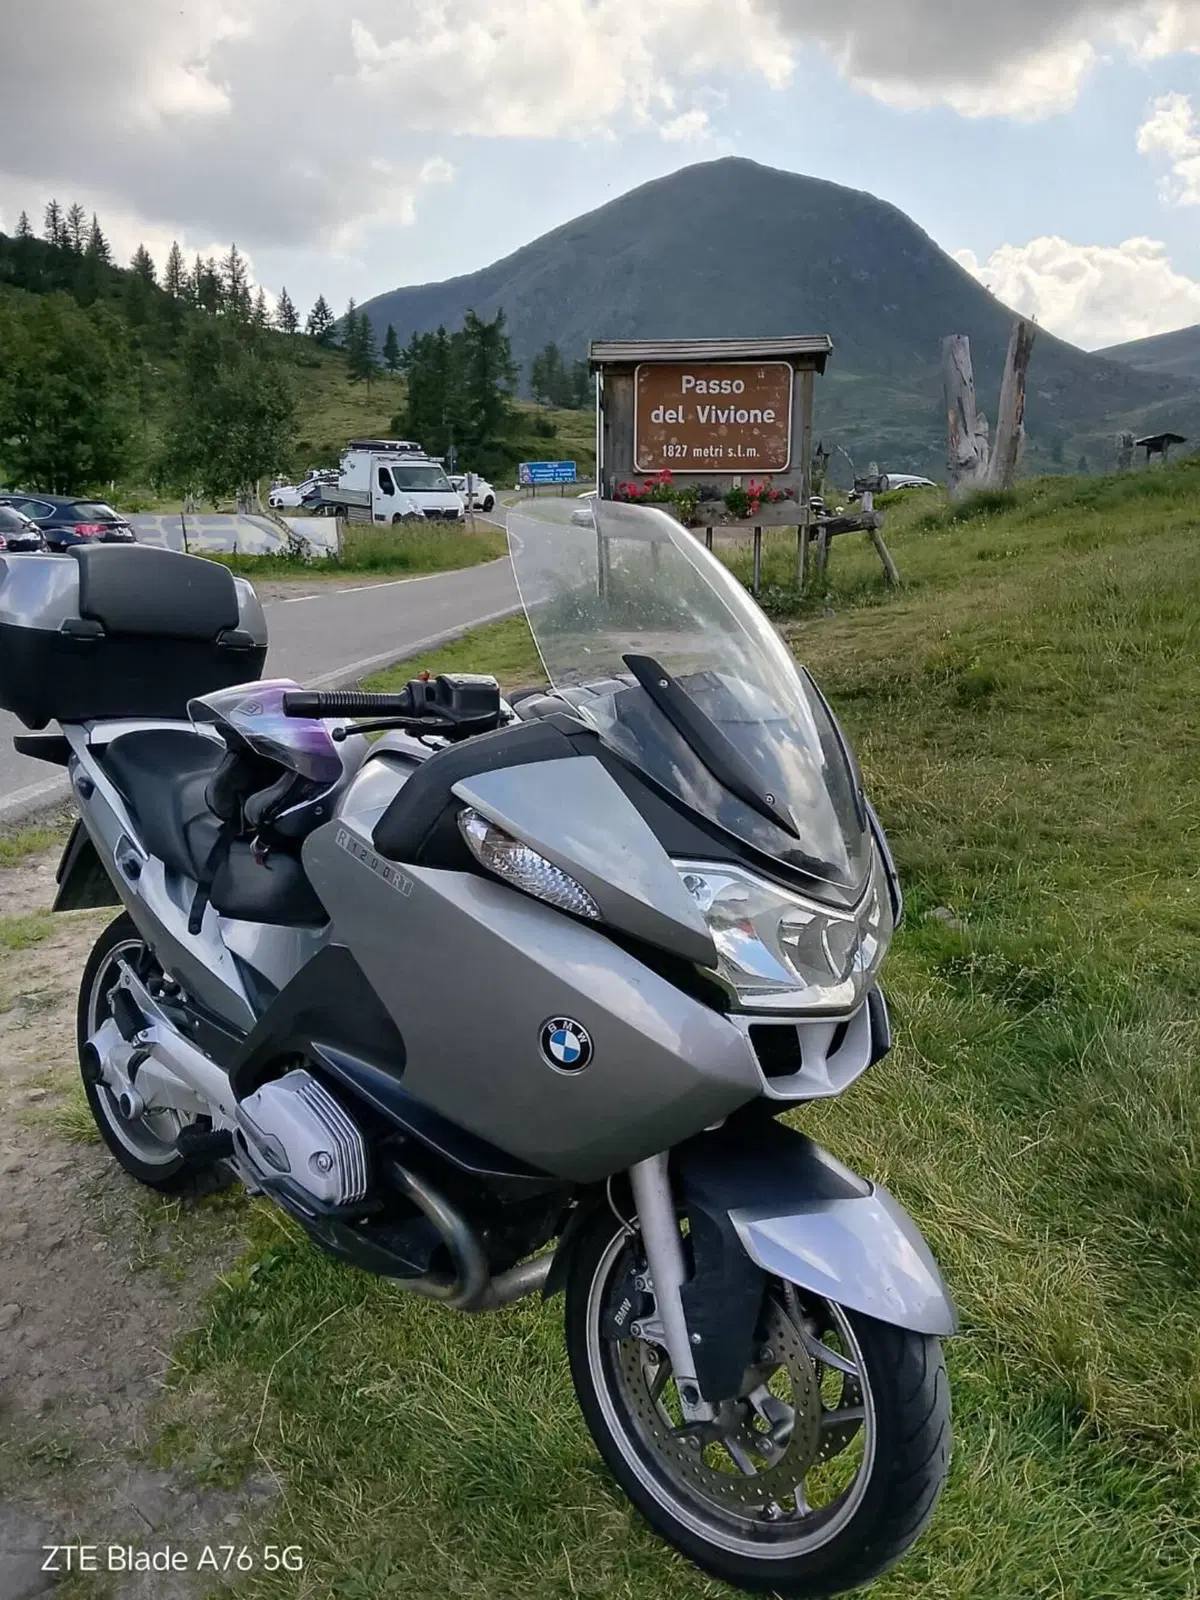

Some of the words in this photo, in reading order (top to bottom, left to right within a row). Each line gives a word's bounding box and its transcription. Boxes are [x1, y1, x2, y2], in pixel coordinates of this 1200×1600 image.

[681, 375, 745, 394] Passo
[650, 405, 685, 424] del
[697, 405, 776, 424] Vivione
[662, 445, 688, 457] 1827
[693, 445, 723, 457] metri
[728, 444, 760, 457] s.l.m.
[547, 1020, 588, 1043] BMW
[613, 1297, 632, 1326] BMW
